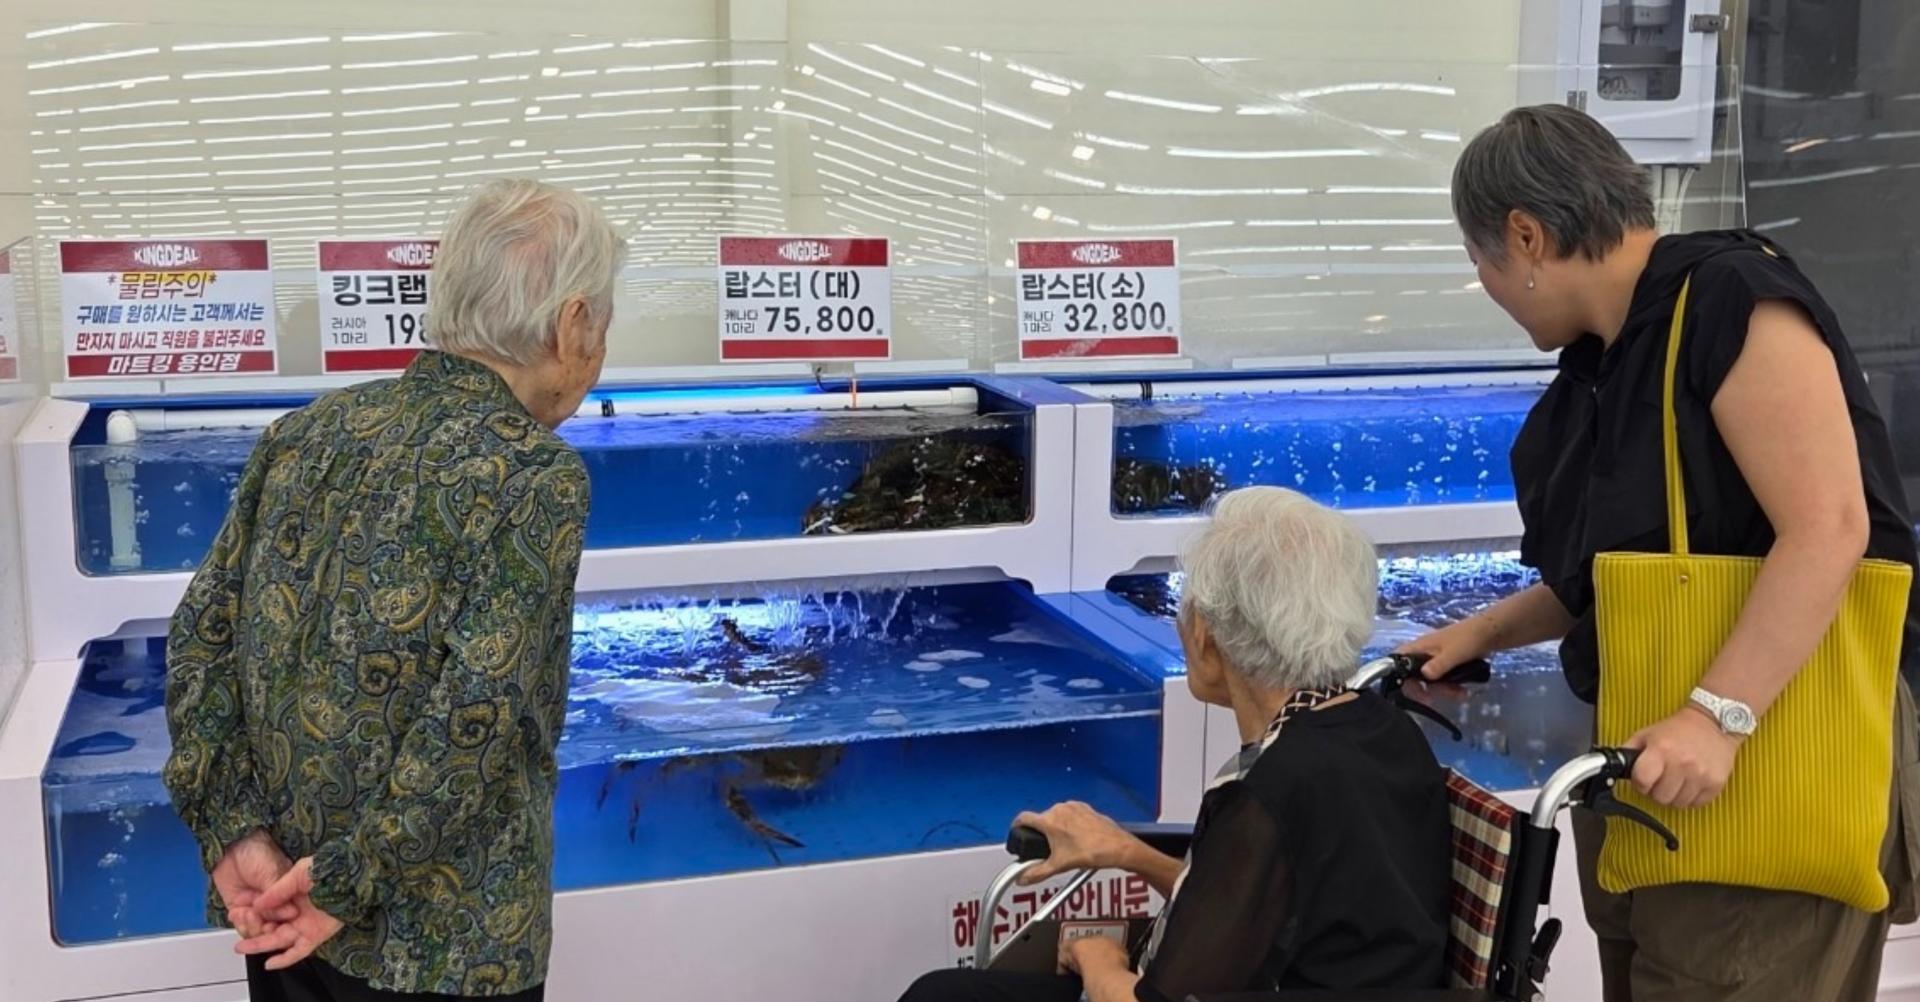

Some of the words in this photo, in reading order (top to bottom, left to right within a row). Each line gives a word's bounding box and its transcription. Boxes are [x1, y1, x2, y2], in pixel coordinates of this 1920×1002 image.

[134, 244, 199, 267] KINGDEAL
[777, 241, 832, 262] KINGDEAL
[1071, 243, 1123, 264] KINGDEAL
[332, 274, 428, 306] 킹크랩
[77, 305, 122, 325] 구매를
[127, 303, 187, 324] 원하시는
[190, 302, 264, 322] 고객께서는
[331, 316, 367, 330] 러시아
[724, 308, 758, 320] 캐나다
[1023, 310, 1054, 322] 캐나다
[332, 331, 368, 345] 1마리
[725, 322, 755, 334] 1마리
[1023, 322, 1052, 334] 1마리
[76, 331, 116, 351] 만지지
[119, 331, 158, 350] 마시고
[162, 329, 199, 349] 직원을
[203, 329, 265, 348] 불러주세요
[107, 355, 174, 375] 마트킹
[177, 353, 240, 372] 용인점
